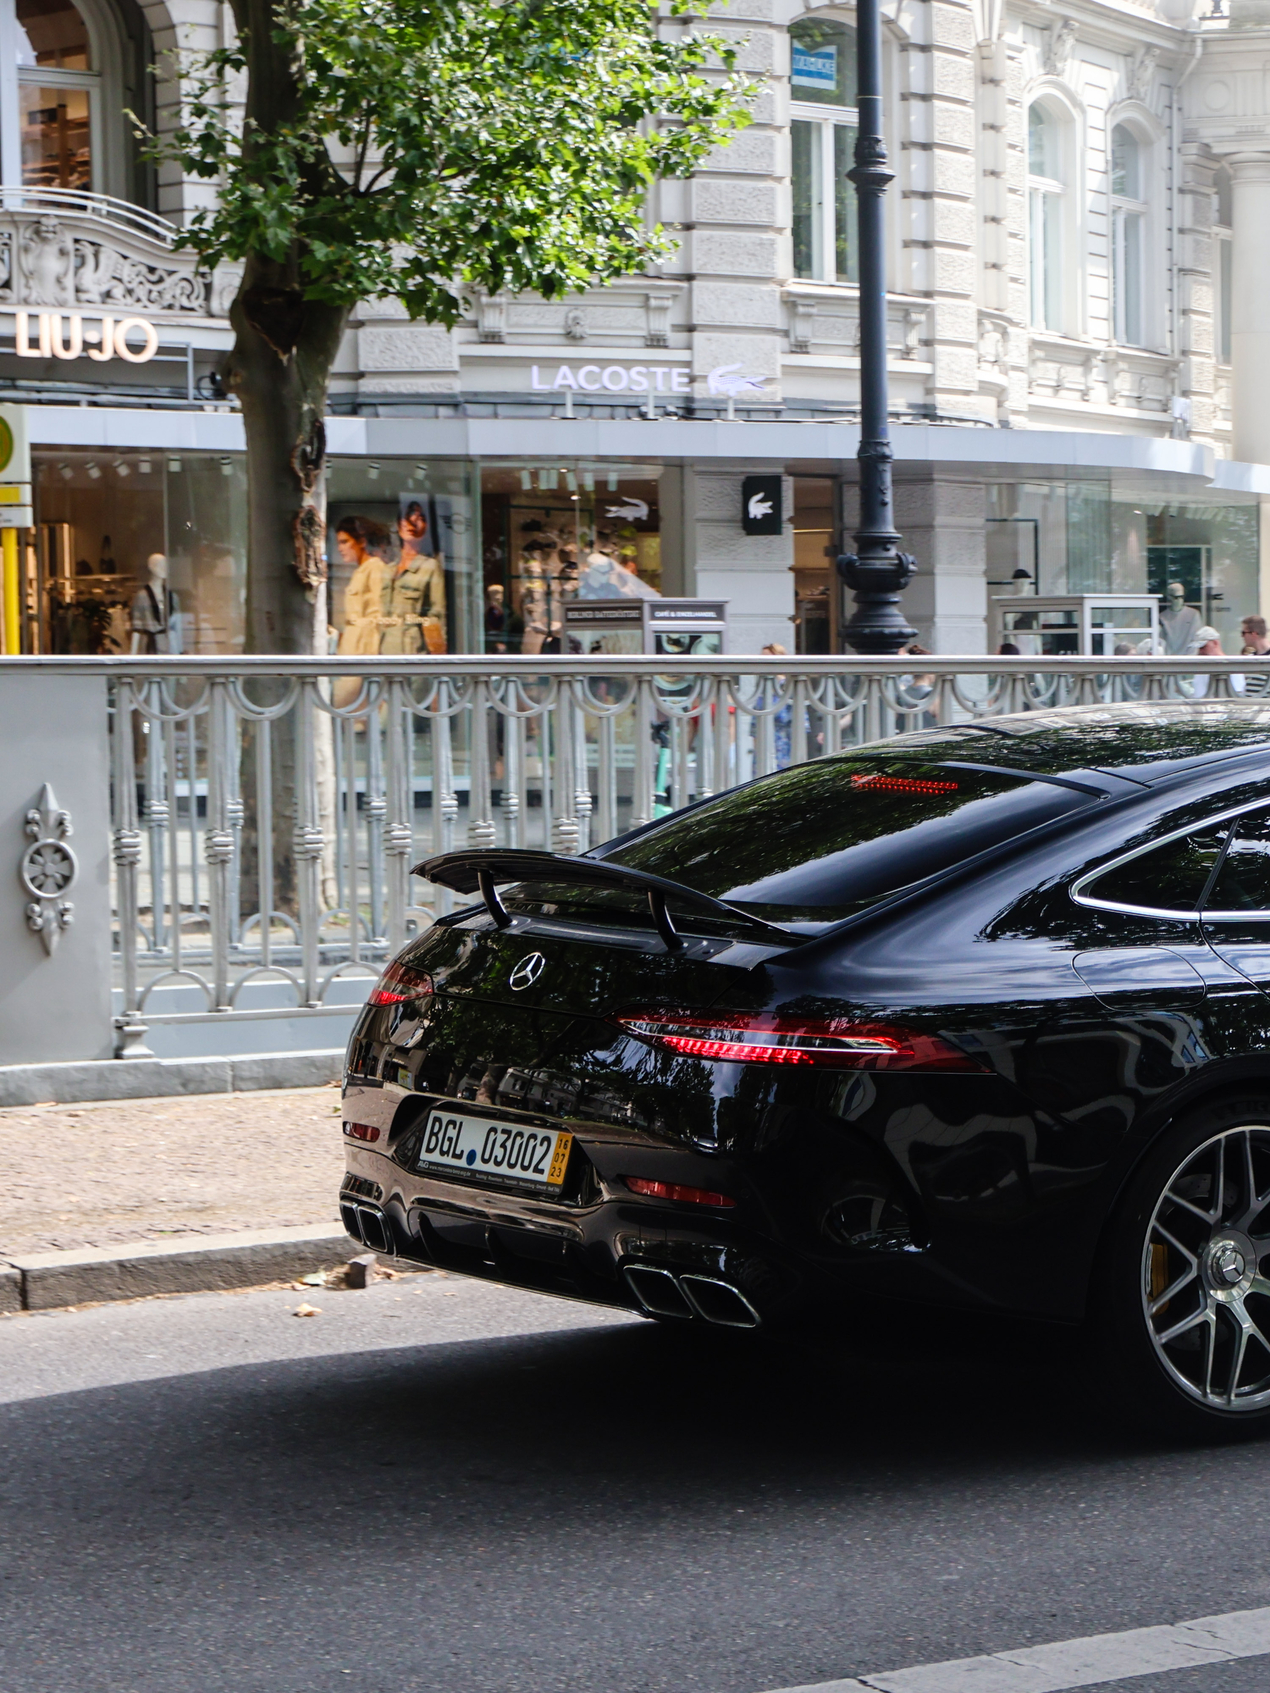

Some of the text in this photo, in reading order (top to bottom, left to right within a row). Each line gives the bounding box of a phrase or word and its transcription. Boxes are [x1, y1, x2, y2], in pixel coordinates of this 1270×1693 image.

[531, 365, 691, 392] LACOSTE
[424, 1116, 552, 1175] BGL 03002
[558, 1138, 569, 1150] 16
[553, 1152, 566, 1164] 07
[550, 1166, 562, 1178] 23
